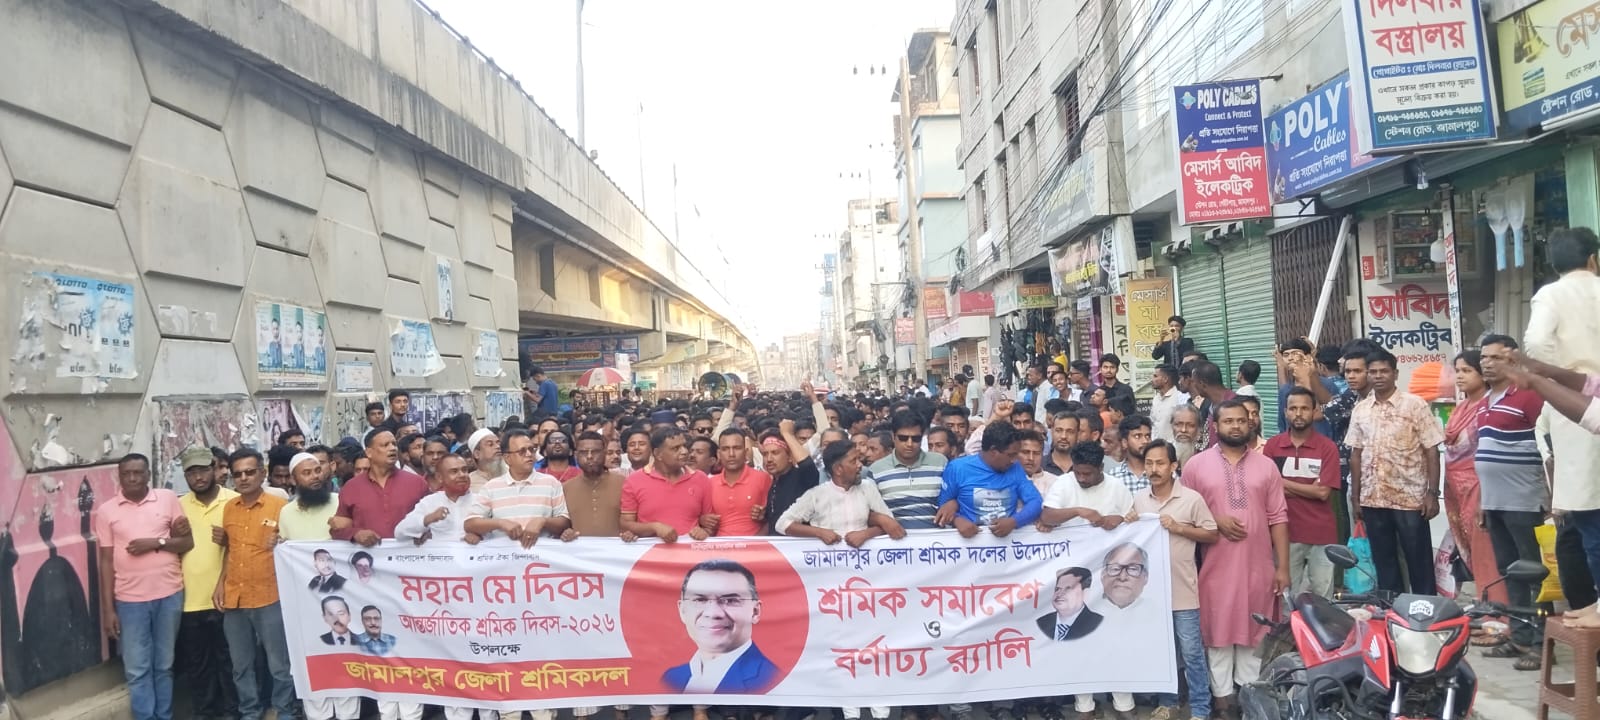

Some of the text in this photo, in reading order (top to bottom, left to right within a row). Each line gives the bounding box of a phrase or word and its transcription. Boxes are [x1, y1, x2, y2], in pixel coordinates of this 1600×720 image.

[1371, 21, 1468, 57] বস্ত্রালয়
[1197, 84, 1257, 109] POLY CABLES
[1205, 111, 1226, 121] Connect
[1232, 110, 1252, 119] Protect
[1284, 82, 1343, 148] POLY
[1313, 127, 1346, 153] Cables
[1184, 152, 1262, 177] মেসার্স আবিদ
[1194, 173, 1254, 198] ইলেকট্রিক
[62, 279, 88, 289] LOTTO
[103, 285, 127, 295] LOTTO
[1131, 284, 1168, 302] মেসার্স
[1138, 304, 1160, 320] মা
[1367, 284, 1450, 321] আবিদ
[803, 539, 1072, 570] জামালপুর জেলা শ্রমিক দলের উদ্যোগে
[398, 562, 604, 606] মহান মে দিবস
[817, 576, 1045, 622] শ্রমিক সমাবেশ
[399, 609, 615, 637] আন্তর্জাতিক শ্রমিক দিবস-২০২৬
[923, 620, 941, 639] ও
[469, 641, 522, 657] উপলক্ষে
[831, 635, 934, 679] বর্ণাঢ্য
[343, 661, 631, 692] জামালপুর জেলা শ্রমিকদল
